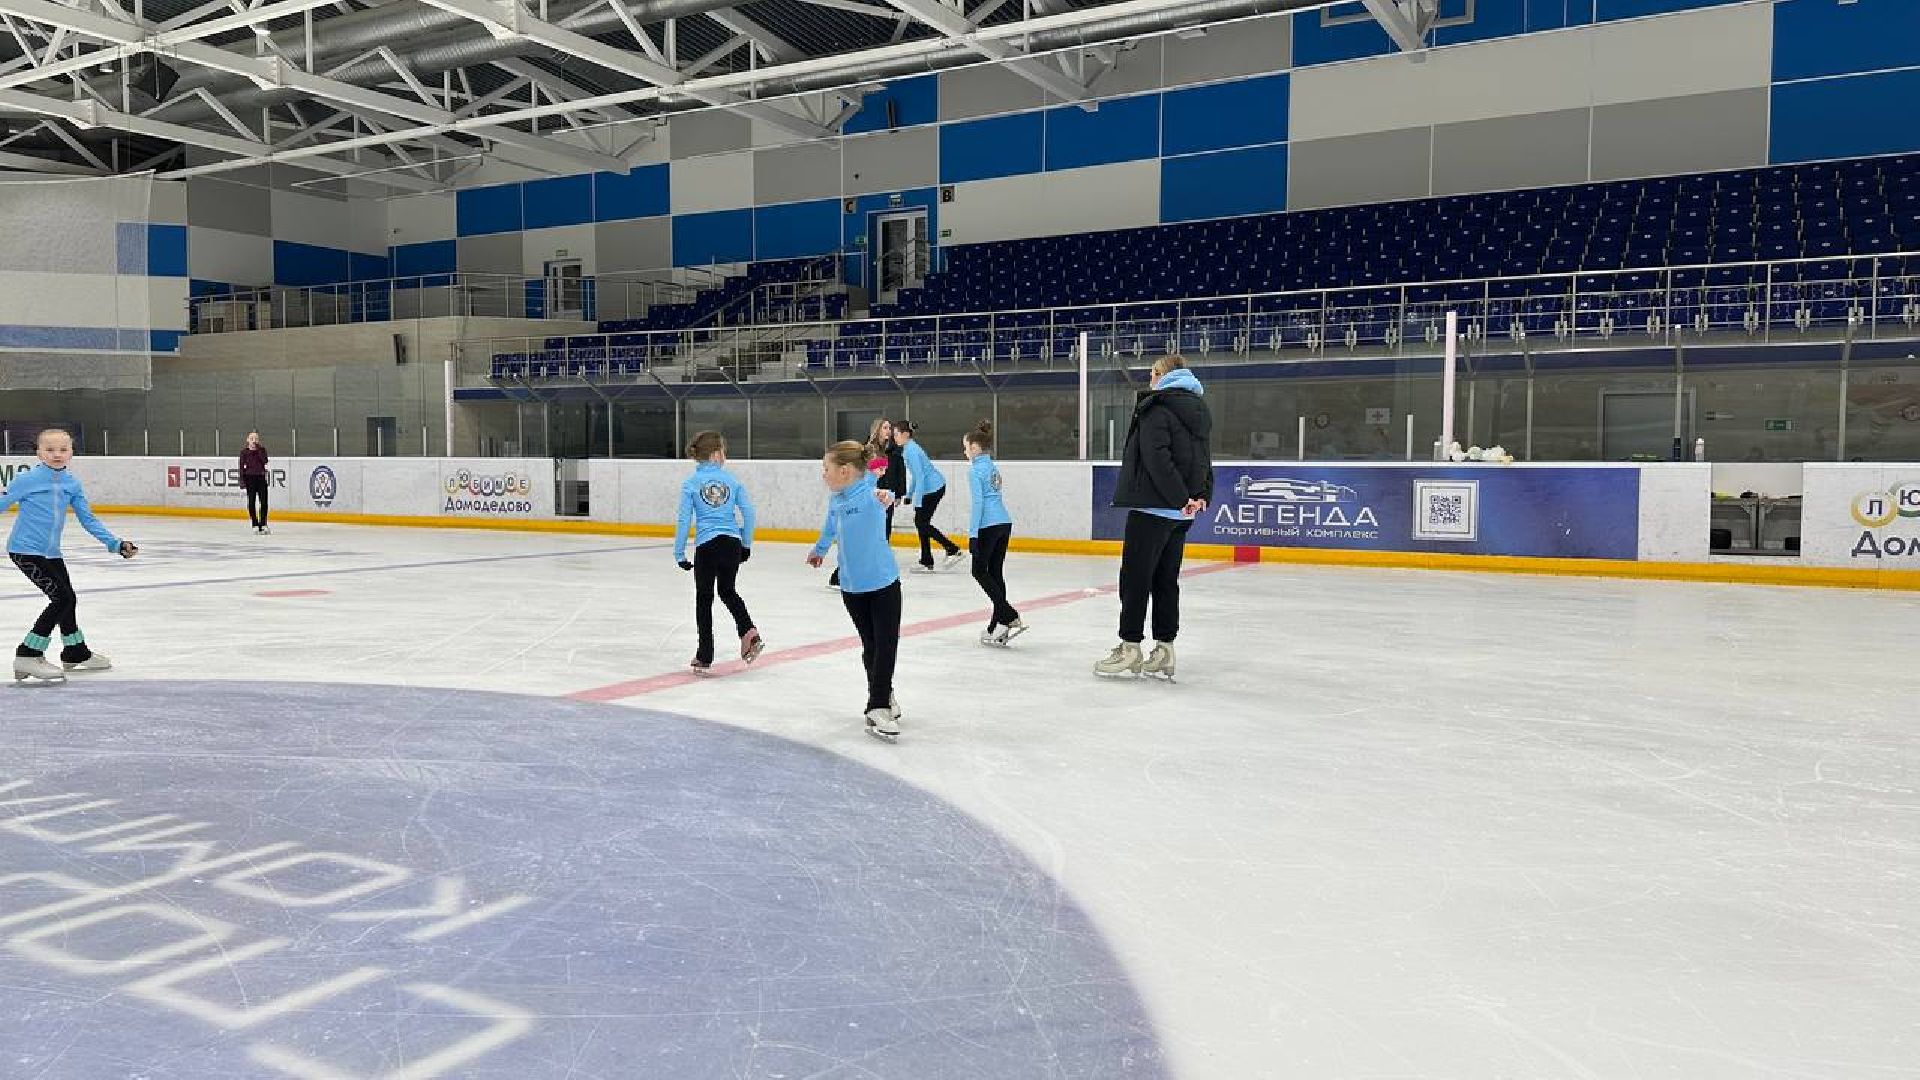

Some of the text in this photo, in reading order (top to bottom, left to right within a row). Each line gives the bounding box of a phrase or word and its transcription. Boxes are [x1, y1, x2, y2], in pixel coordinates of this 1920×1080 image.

[185, 468, 286, 488] PROSR
[445, 496, 532, 513] Домодедово
[1214, 503, 1379, 527] ЛЕГЕНДА
[1213, 525, 1379, 539] Спортивный комплекс
